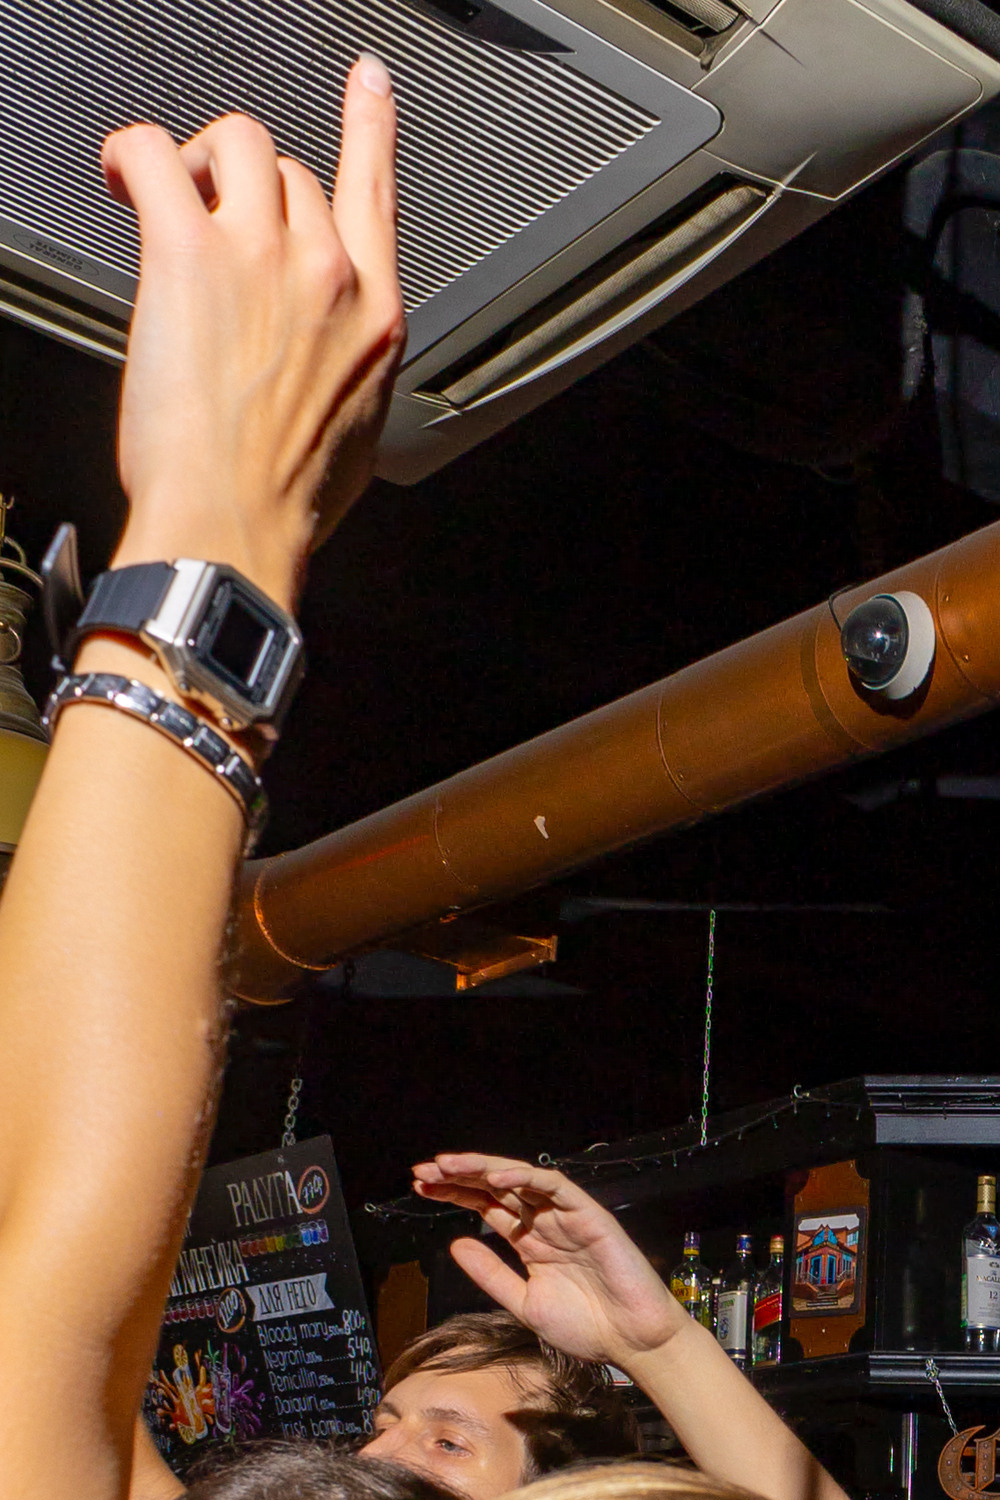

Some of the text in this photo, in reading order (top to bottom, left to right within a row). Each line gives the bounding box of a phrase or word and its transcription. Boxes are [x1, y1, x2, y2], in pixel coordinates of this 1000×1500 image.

[226, 1170, 304, 1228] РАДУГА
[258, 1279, 317, 1315] ДЛЯ НЕГО
[989, 1290, 998, 1300] 12
[257, 1320, 298, 1347] Bloody
[263, 1347, 306, 1372] Negroni
[268, 1367, 320, 1393] Penicillin
